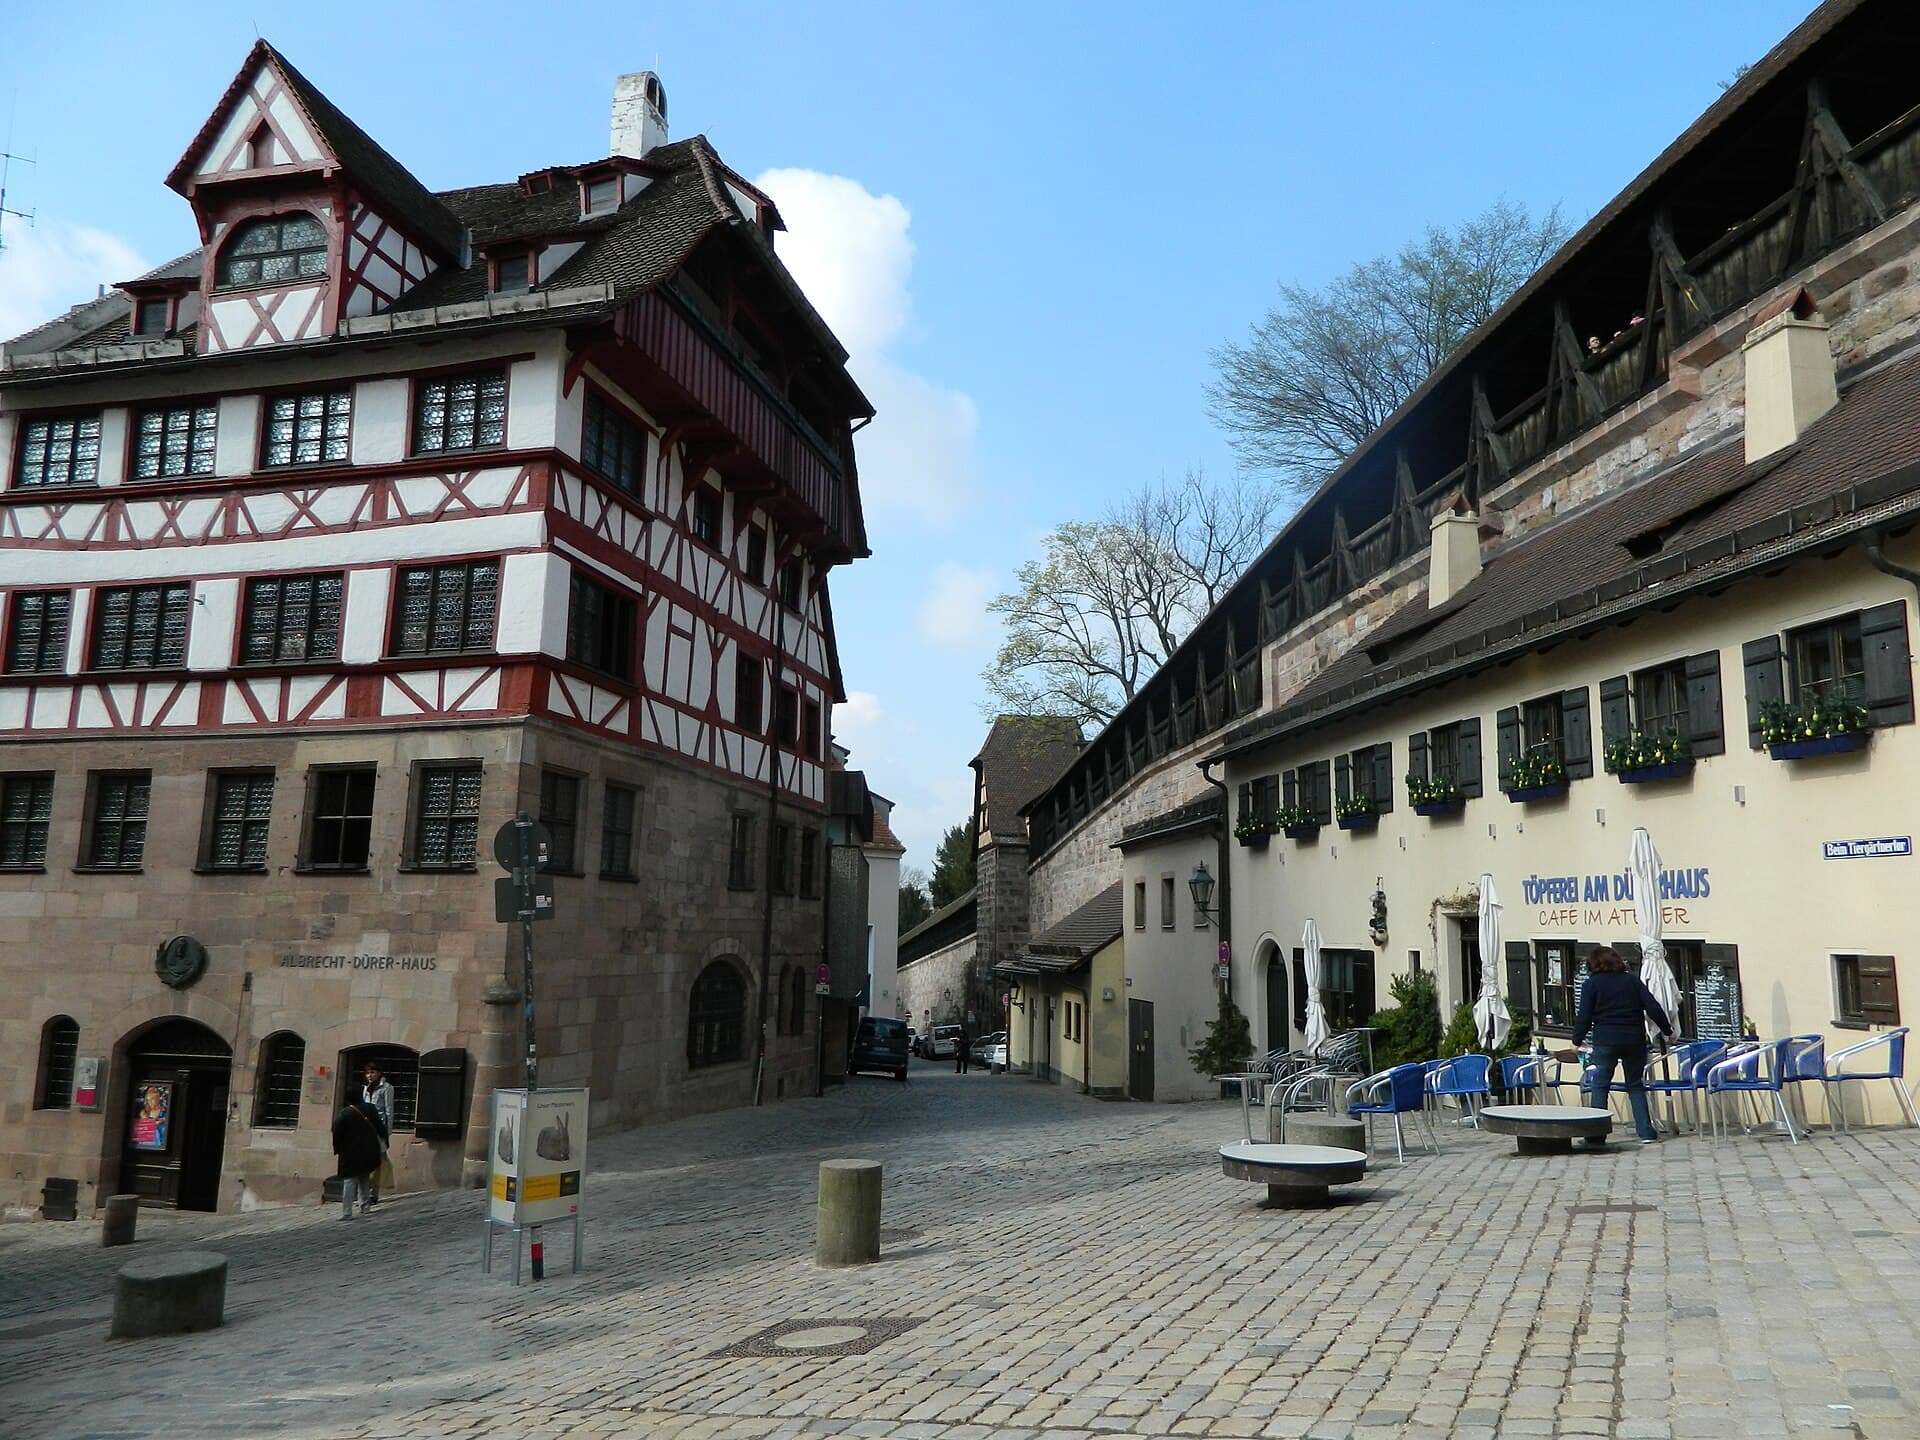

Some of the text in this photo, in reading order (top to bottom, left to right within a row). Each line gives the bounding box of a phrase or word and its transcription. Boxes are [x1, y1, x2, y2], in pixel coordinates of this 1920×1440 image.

[1827, 842, 1847, 856] Beim
[1522, 867, 1711, 905] TÖPFEREI AM DÜRHAUS
[1539, 905, 1690, 926] CAFÉ IM ATER
